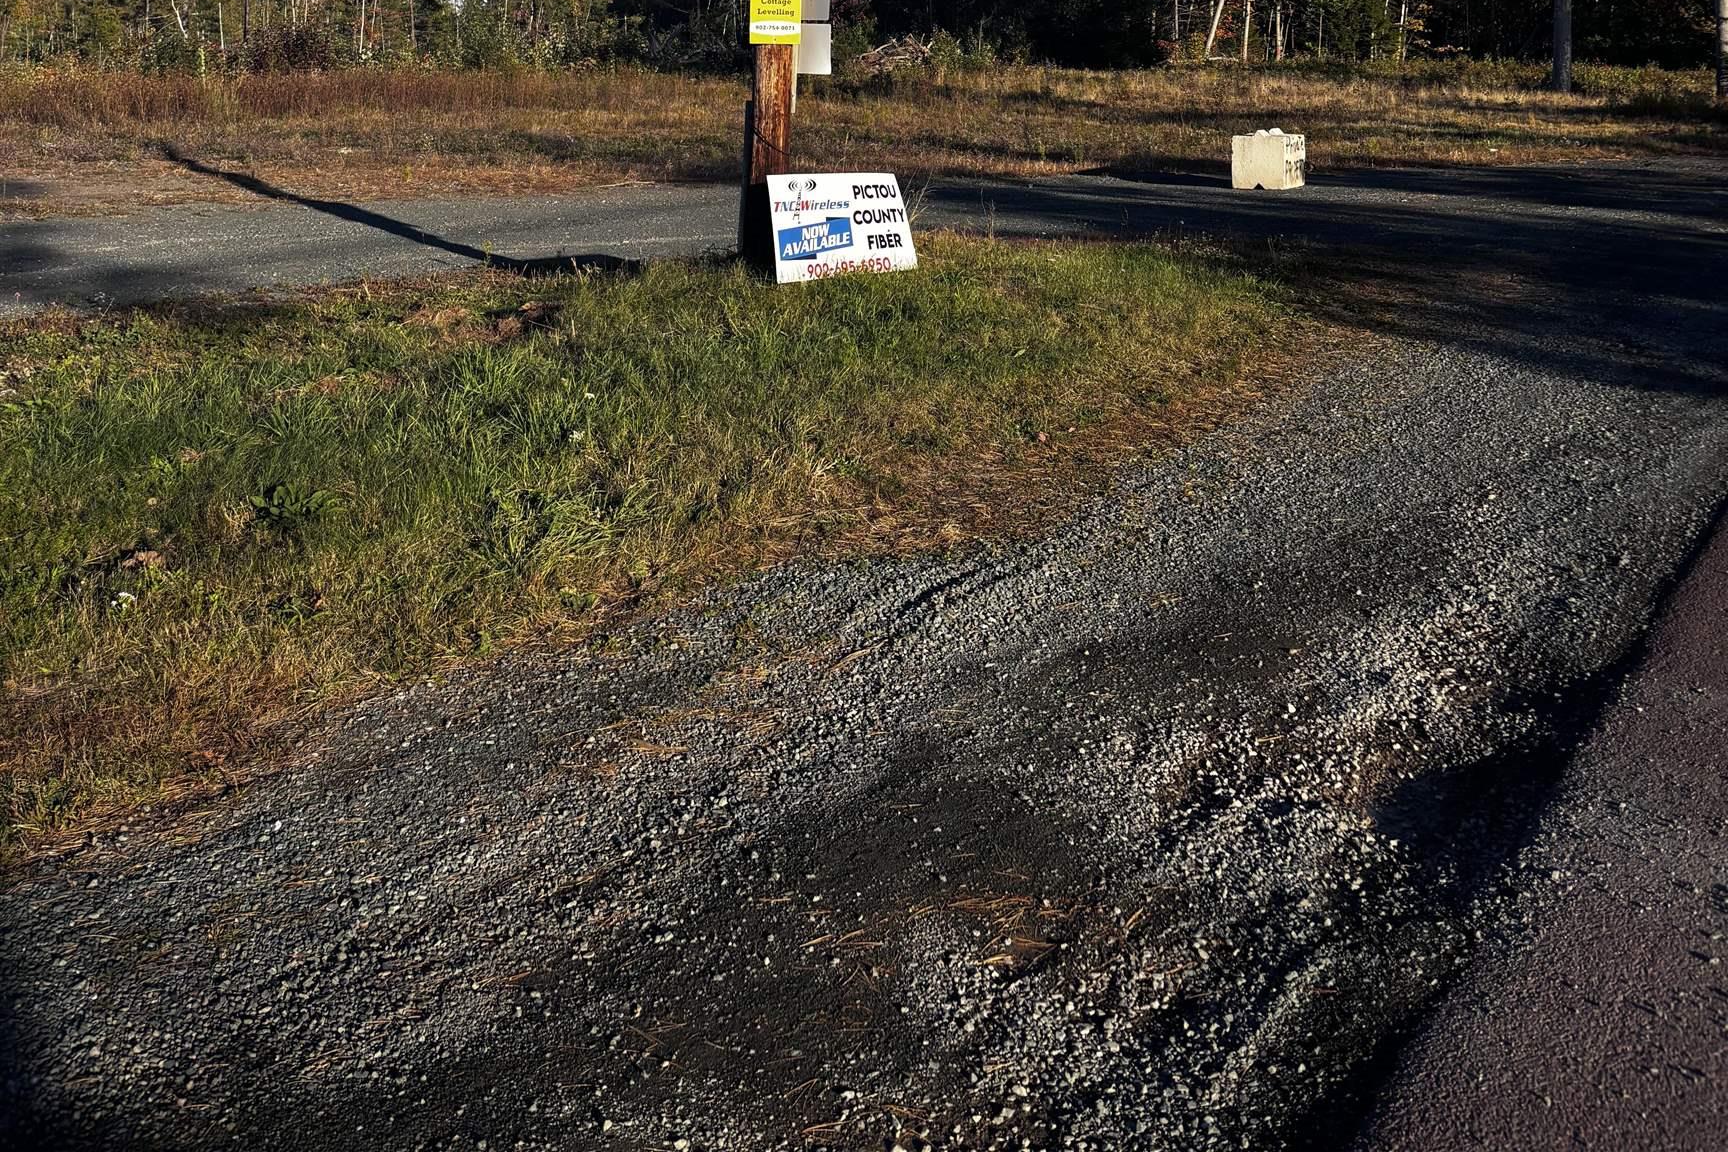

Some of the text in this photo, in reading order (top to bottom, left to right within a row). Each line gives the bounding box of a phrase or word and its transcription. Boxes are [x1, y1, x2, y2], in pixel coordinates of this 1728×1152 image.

[757, 8, 795, 17] Levelling
[852, 184, 897, 199] PICTOU
[853, 208, 905, 225] COUNTY
[801, 223, 830, 241] NOW
[782, 231, 851, 257] AVAILABLE
[867, 233, 903, 250] FIBER
